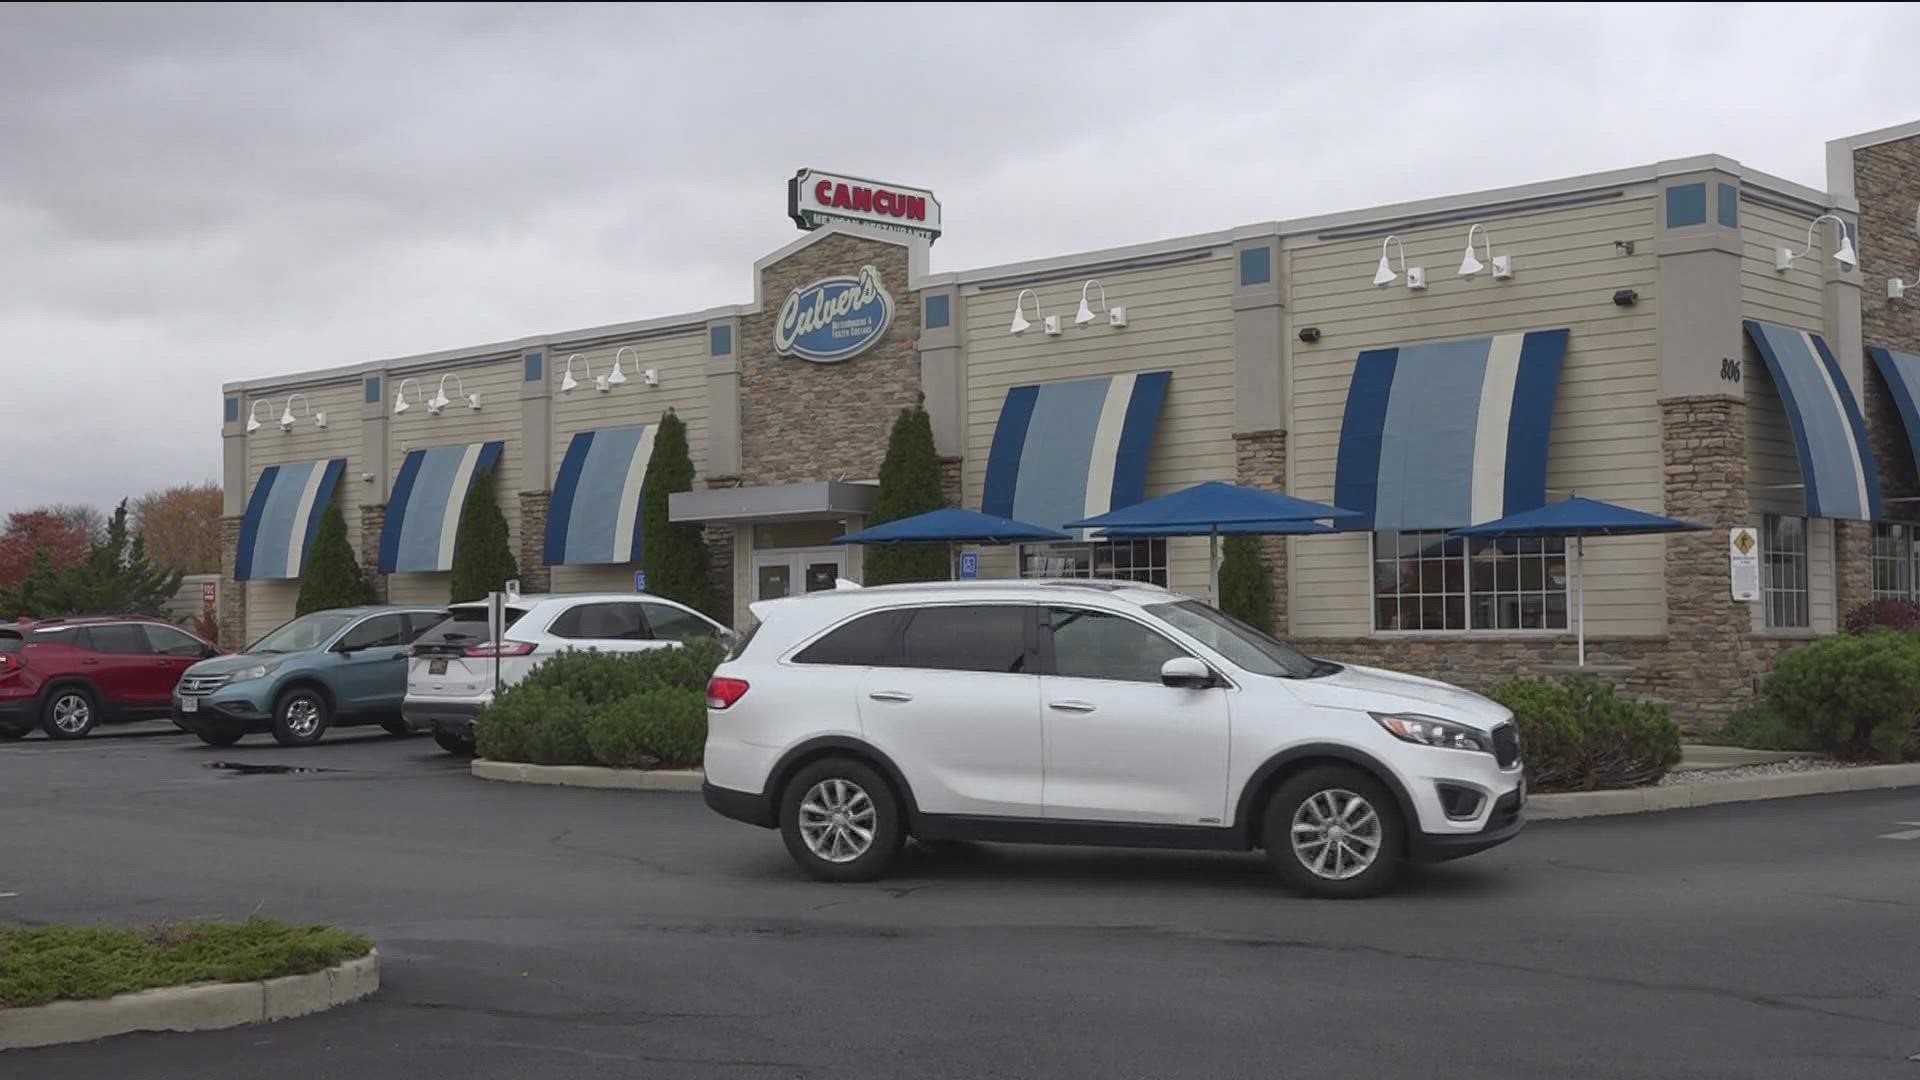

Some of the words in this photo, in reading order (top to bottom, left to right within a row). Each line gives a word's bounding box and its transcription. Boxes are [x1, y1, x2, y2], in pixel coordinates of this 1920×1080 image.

[815, 179, 926, 221] CANCUN
[776, 271, 877, 350] Culver's
[1720, 357, 1741, 383] 806
